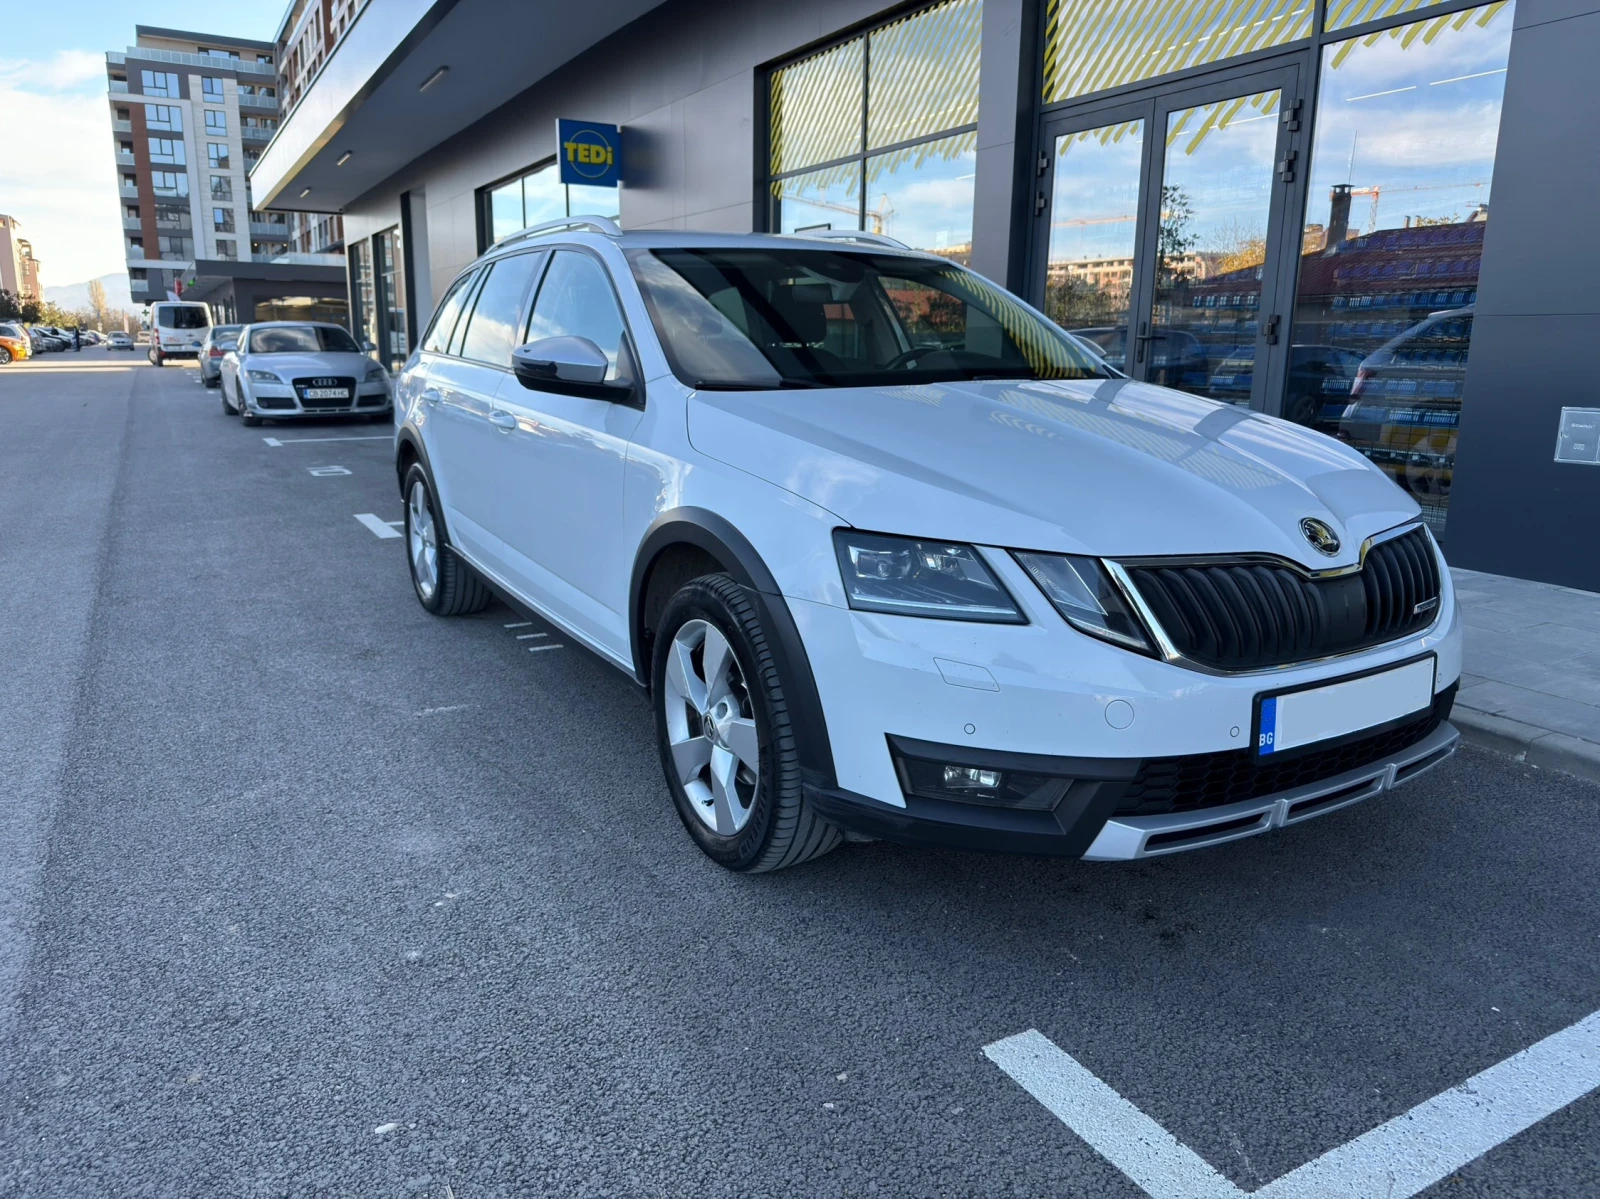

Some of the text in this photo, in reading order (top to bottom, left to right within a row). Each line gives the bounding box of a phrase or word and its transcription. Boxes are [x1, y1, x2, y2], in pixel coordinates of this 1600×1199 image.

[564, 142, 613, 165] TEDi
[1259, 732, 1273, 746] BG
[740, 784, 767, 856] MICHELIN
